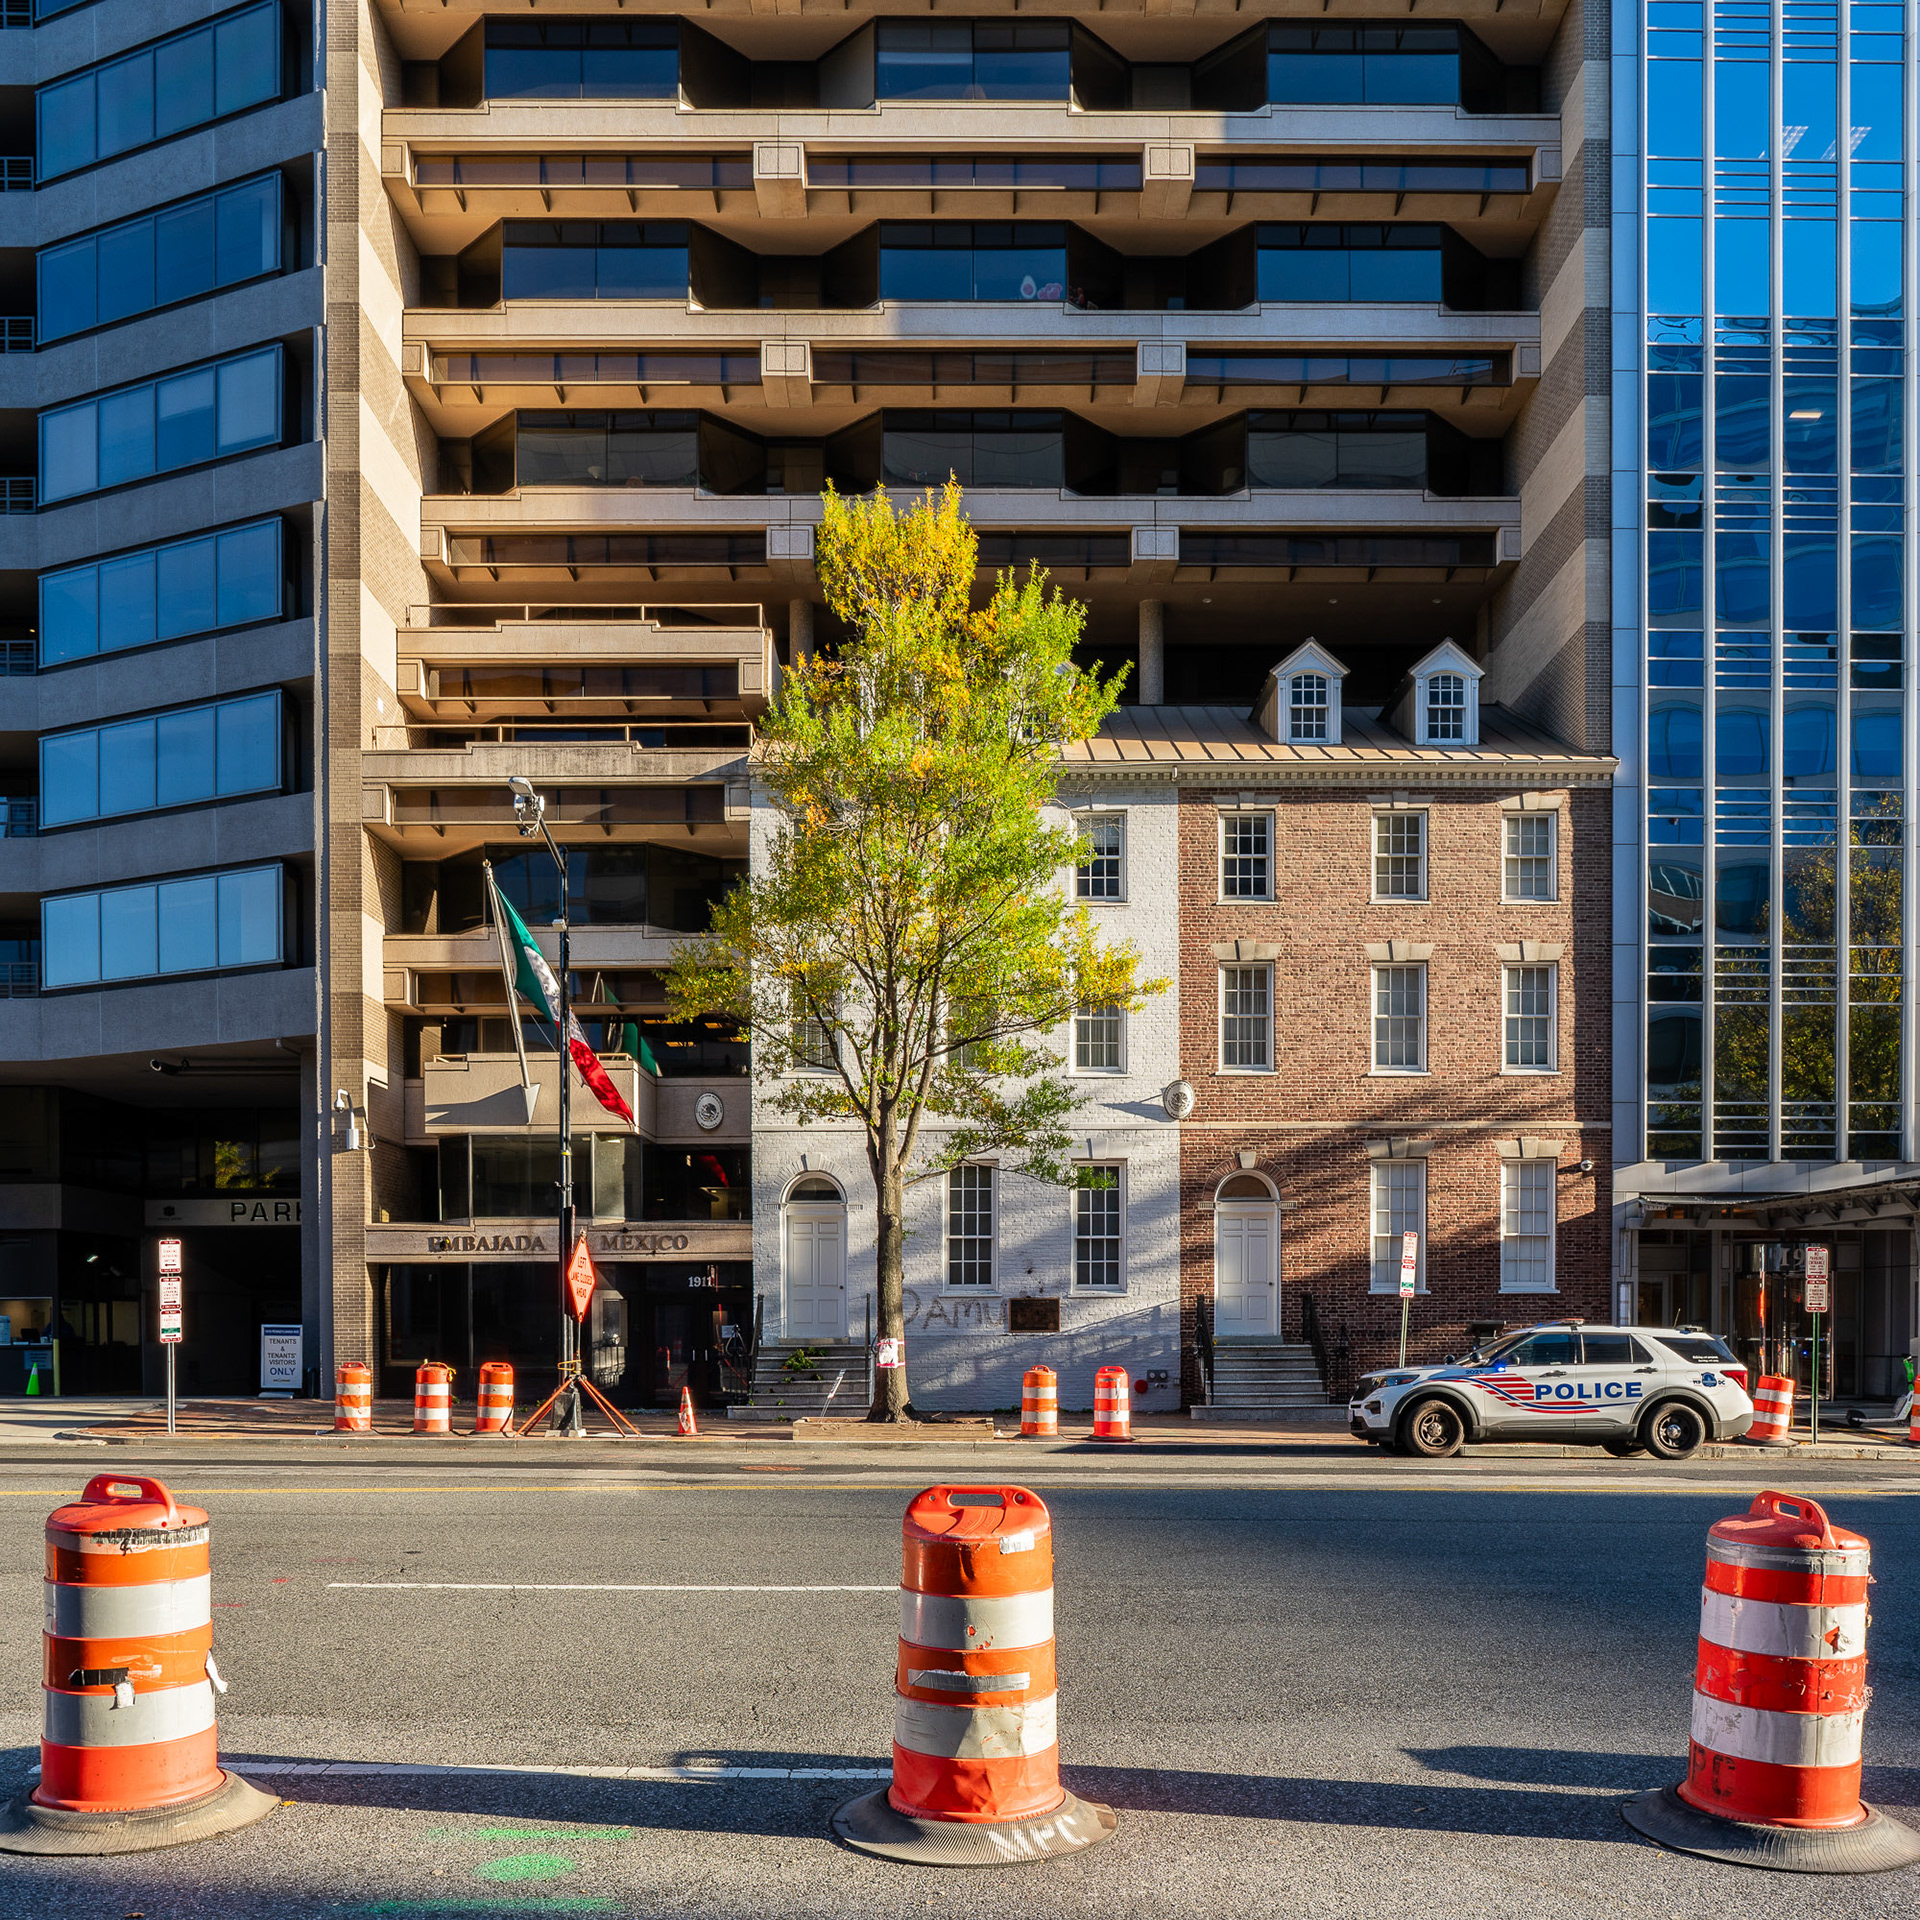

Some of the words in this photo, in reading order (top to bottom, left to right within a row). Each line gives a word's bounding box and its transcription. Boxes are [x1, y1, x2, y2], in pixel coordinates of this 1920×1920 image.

[427, 1235, 546, 1253] EMBAJADA
[601, 1234, 689, 1251] MEXICO
[577, 1256, 587, 1269] LEFT
[571, 1272, 579, 1283] LANE
[580, 1273, 592, 1285] CLOSED
[688, 1276, 712, 1287] 1911
[576, 1287, 587, 1298] AHEAD
[269, 1367, 296, 1376] ONLY
[1535, 1381, 1643, 1401] POLICE
